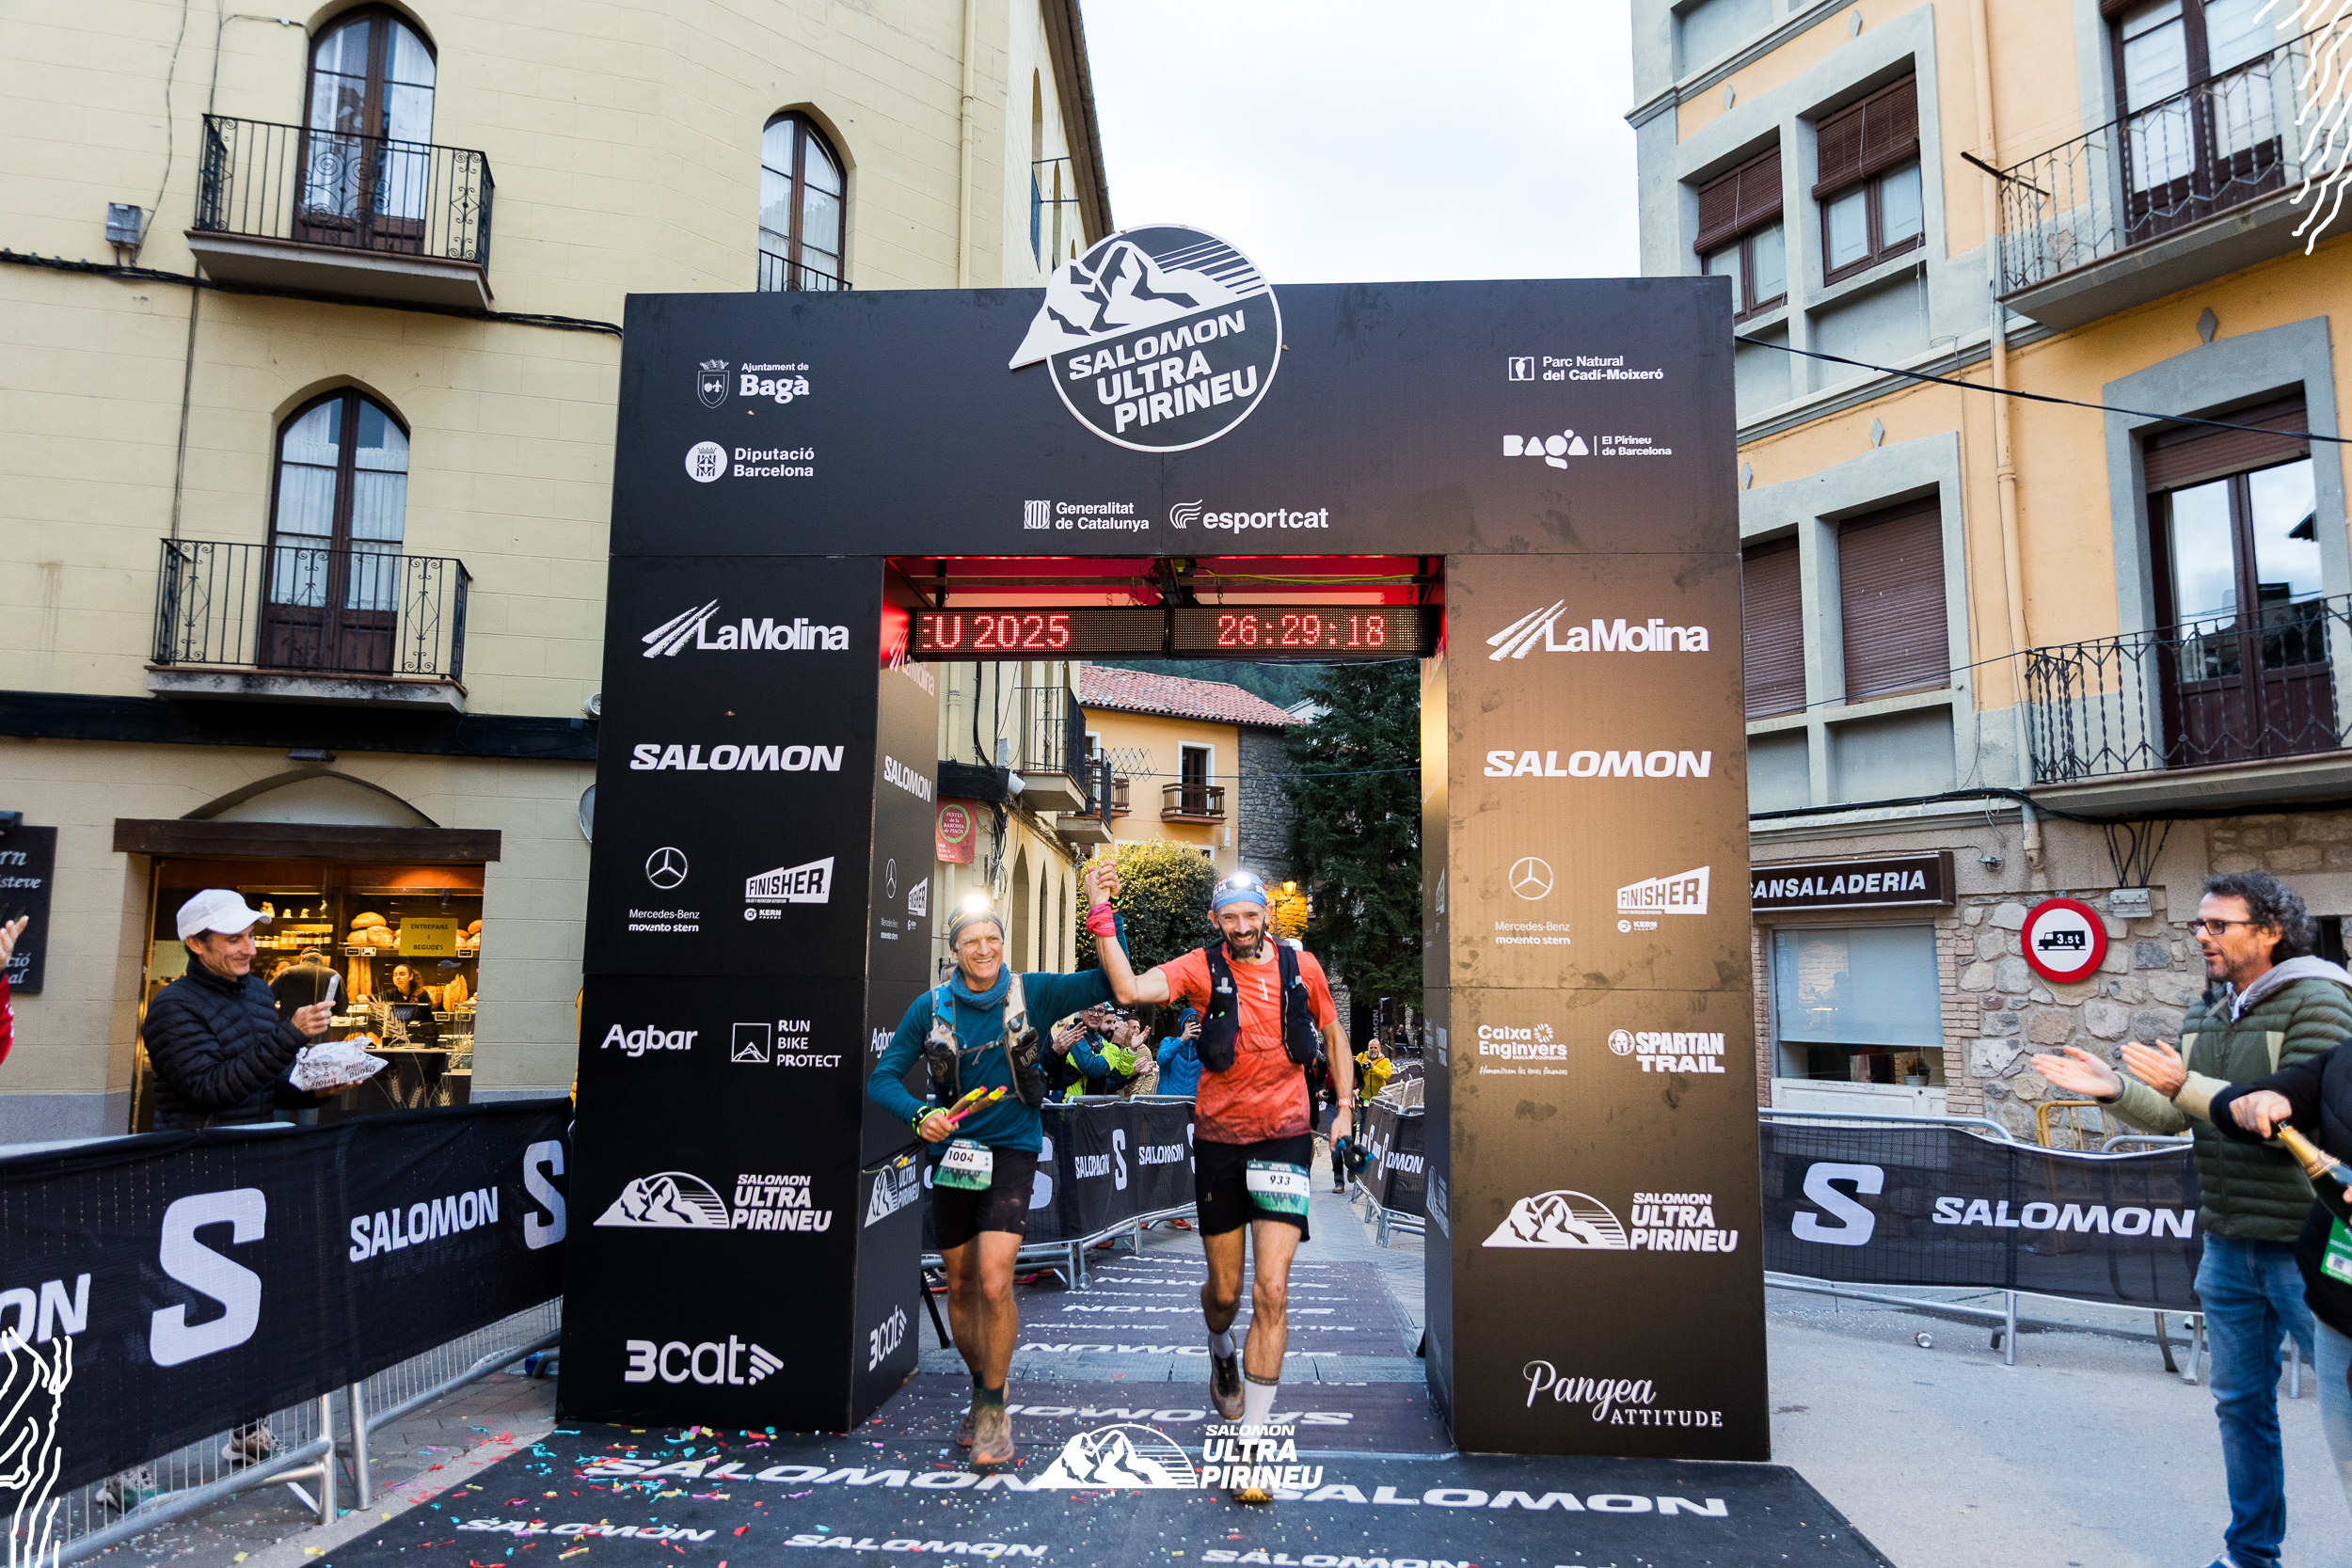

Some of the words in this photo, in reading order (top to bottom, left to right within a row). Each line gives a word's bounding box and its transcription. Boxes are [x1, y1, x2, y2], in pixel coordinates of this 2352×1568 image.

[1070, 309, 1245, 381] SALOMON
[741, 363, 795, 372] Ajuntament
[1543, 356, 1572, 367] Parc
[1577, 356, 1623, 366] Natural
[1098, 353, 1211, 404] ULTRA
[1543, 370, 1565, 380] del
[1569, 369, 1663, 380] Cadí-Moixeró
[739, 374, 809, 404] Bagà
[1116, 366, 1258, 433] PIRINEU
[1602, 447, 1615, 455] de
[1618, 447, 1672, 455] Barcelona
[1615, 436, 1651, 444] Pirineu
[735, 448, 814, 463] Diputació
[734, 465, 813, 477] Barcelona
[1057, 502, 1134, 514] Generalitat
[1056, 517, 1073, 530] de
[1078, 517, 1149, 532] Catalunya
[1203, 508, 1328, 533] esportcat
[975, 616, 1069, 647] 2025
[1218, 615, 1384, 645] 26:29:18
[630, 744, 844, 771] SALOMON
[1484, 751, 1711, 777] SALOMON
[884, 755, 931, 802] SALOMON
[1750, 870, 1926, 898] ANSALADERIA
[629, 910, 699, 919] Mercedes-Benz
[1495, 922, 1570, 932] Mercedes-Benz
[1496, 936, 1541, 944] movento
[779, 1020, 810, 1032] RUN
[1478, 1024, 1532, 1040] Caixa
[601, 1024, 698, 1056] Agbar
[778, 1037, 808, 1049] BIKE
[1479, 1040, 1567, 1060] Enginyers
[1635, 1032, 1724, 1055] SPARTAN
[777, 1054, 841, 1067] PROTECT
[1637, 1056, 1724, 1073] TRAIL
[948, 1150, 974, 1163] 1004
[1138, 1143, 1184, 1165] SALOMON
[738, 1175, 811, 1186] SALOMON
[899, 1164, 915, 1188] ULTRA
[1270, 1175, 1290, 1185] 933
[734, 1187, 811, 1208] ULTRA
[1633, 1193, 1711, 1204] SALOMON
[1791, 1162, 1884, 1245] S
[348, 1186, 498, 1262] SALOMON
[731, 1209, 832, 1232] PIRINEU
[1631, 1205, 1715, 1227] ULTRA
[1931, 1196, 2196, 1240] SALOMON
[1629, 1229, 1738, 1253] PIRINEU
[151, 1188, 266, 1367] S
[869, 1305, 898, 1372] 3cat
[625, 1335, 746, 1385] 3cat
[1523, 1360, 1657, 1422] Pangea
[1611, 1410, 1723, 1427] ATTITUDE
[583, 1459, 1044, 1493] SALOMON
[456, 1519, 716, 1542] SALOMON
[784, 1534, 1048, 1558] SALOMON
